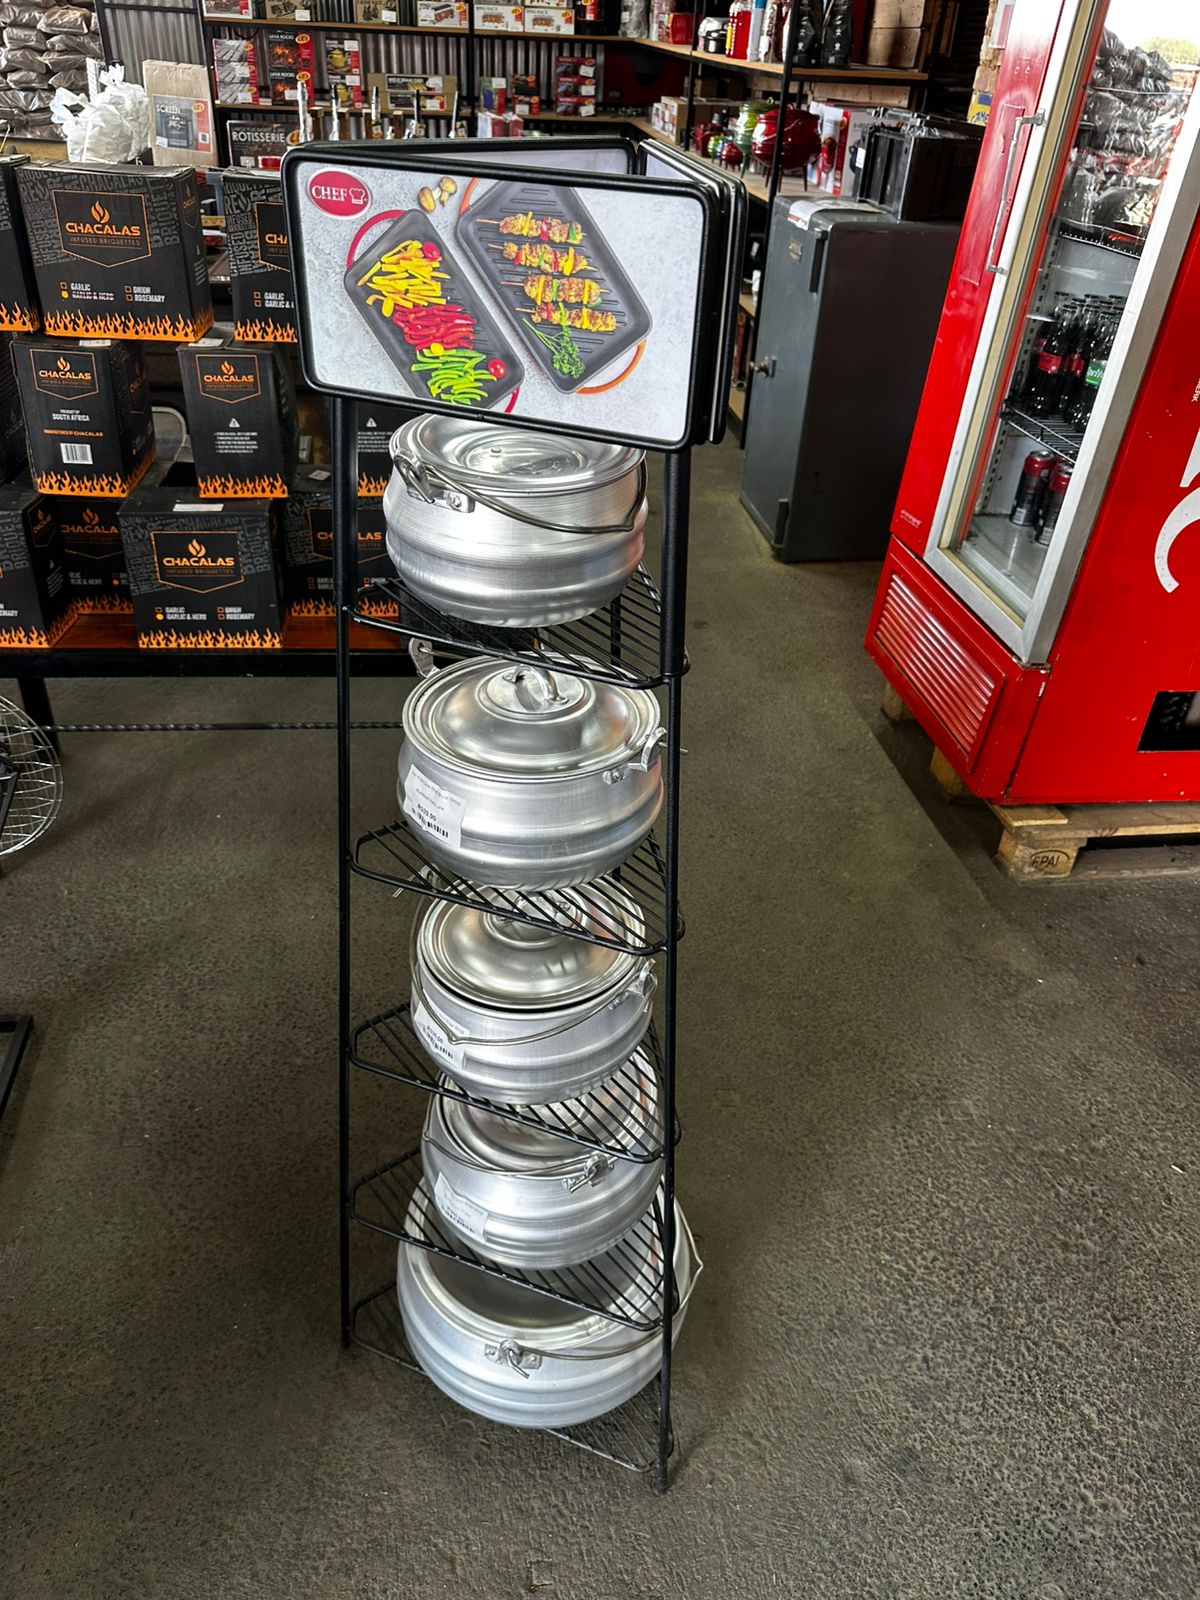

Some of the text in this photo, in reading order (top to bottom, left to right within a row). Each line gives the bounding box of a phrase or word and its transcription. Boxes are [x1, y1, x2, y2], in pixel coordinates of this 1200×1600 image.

[231, 130, 286, 143] ROTISSERIE
[311, 185, 347, 201] CHEF
[65, 222, 142, 237] CHACALAS
[69, 236, 98, 245] INFUSED
[71, 282, 92, 291] GARLIC
[132, 286, 151, 294] ONION
[134, 294, 165, 303] ROSEMARY
[264, 292, 285, 301] GARLIC
[265, 300, 286, 308] GARLIC
[39, 369, 92, 383] CHACALAS
[203, 374, 255, 383] CHACALAS
[52, 413, 92, 422] SOUTH AFRICA
[60, 524, 120, 534] HACALA
[162, 556, 235, 567] CHACALAS
[165, 606, 186, 614] GARLIC
